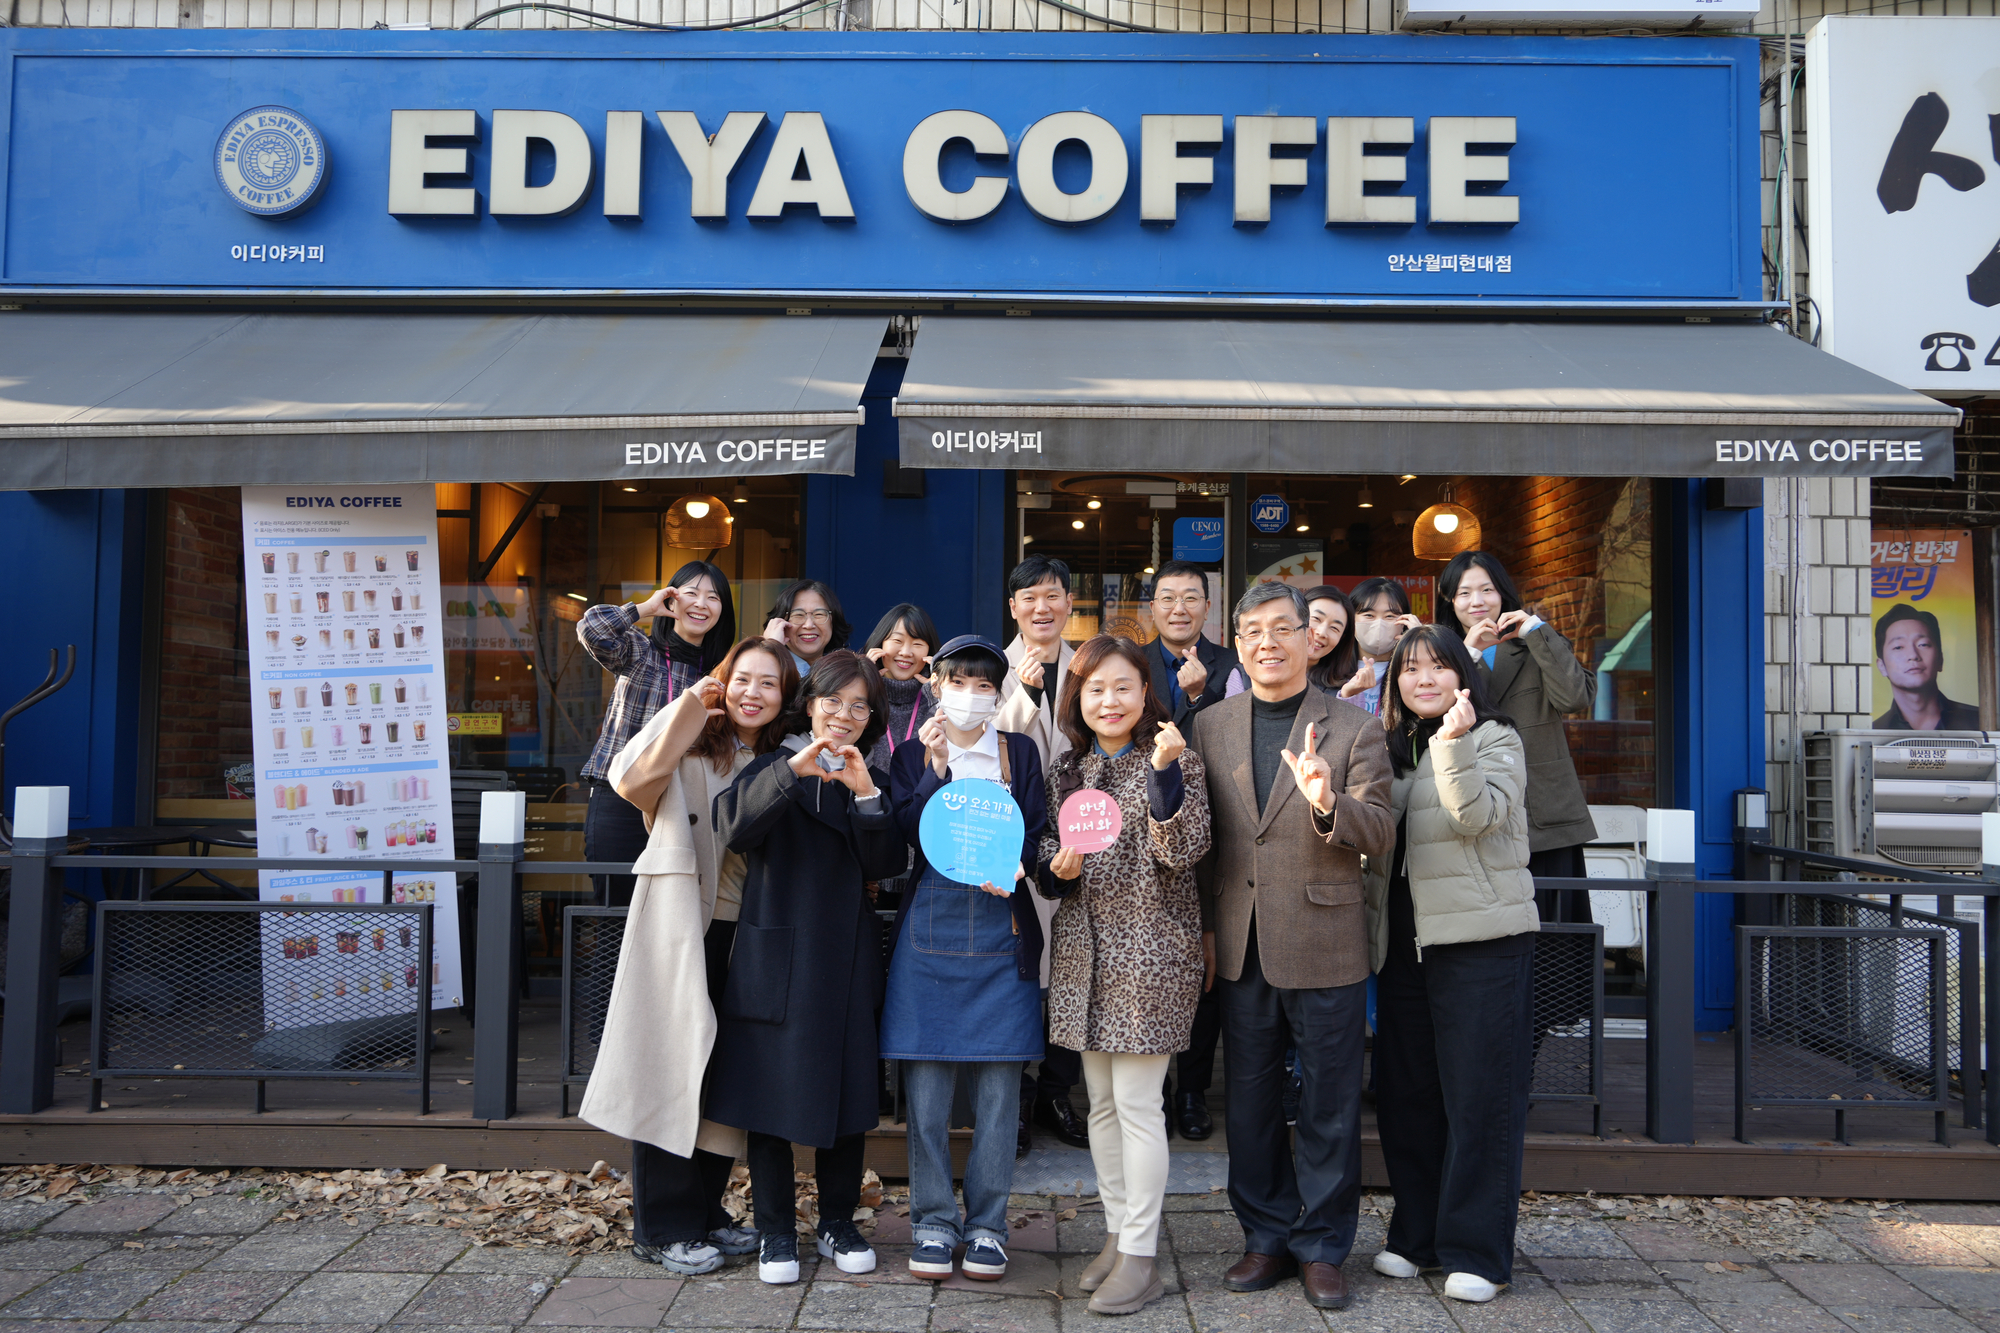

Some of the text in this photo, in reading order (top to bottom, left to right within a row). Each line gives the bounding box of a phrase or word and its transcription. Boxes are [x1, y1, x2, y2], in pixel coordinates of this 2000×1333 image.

[224, 115, 315, 167] EDIYA ESPRESSO
[388, 108, 1520, 226] EDIYA COFFEE
[238, 184, 295, 205] COFFEE
[230, 244, 325, 263] 이디야커피
[1387, 252, 1512, 274] 안산월피현대점
[625, 438, 827, 466] EDIYA COFFEE
[930, 430, 1043, 454] 이디야커피
[1715, 439, 1923, 463] EDIYA COFFEE
[1176, 482, 1230, 493] 휴게음식점
[286, 496, 402, 508] EDIYA COFFEE
[1256, 506, 1284, 521] ADT
[1191, 520, 1221, 532] CESCO
[1913, 540, 1959, 563] 반전
[1871, 565, 1938, 601] 켈리
[1114, 617, 1146, 645] ESPRESSO
[471, 700, 531, 712] COFFEE
[267, 770, 293, 778] 블렌디드
[970, 797, 1014, 815] 오소가게
